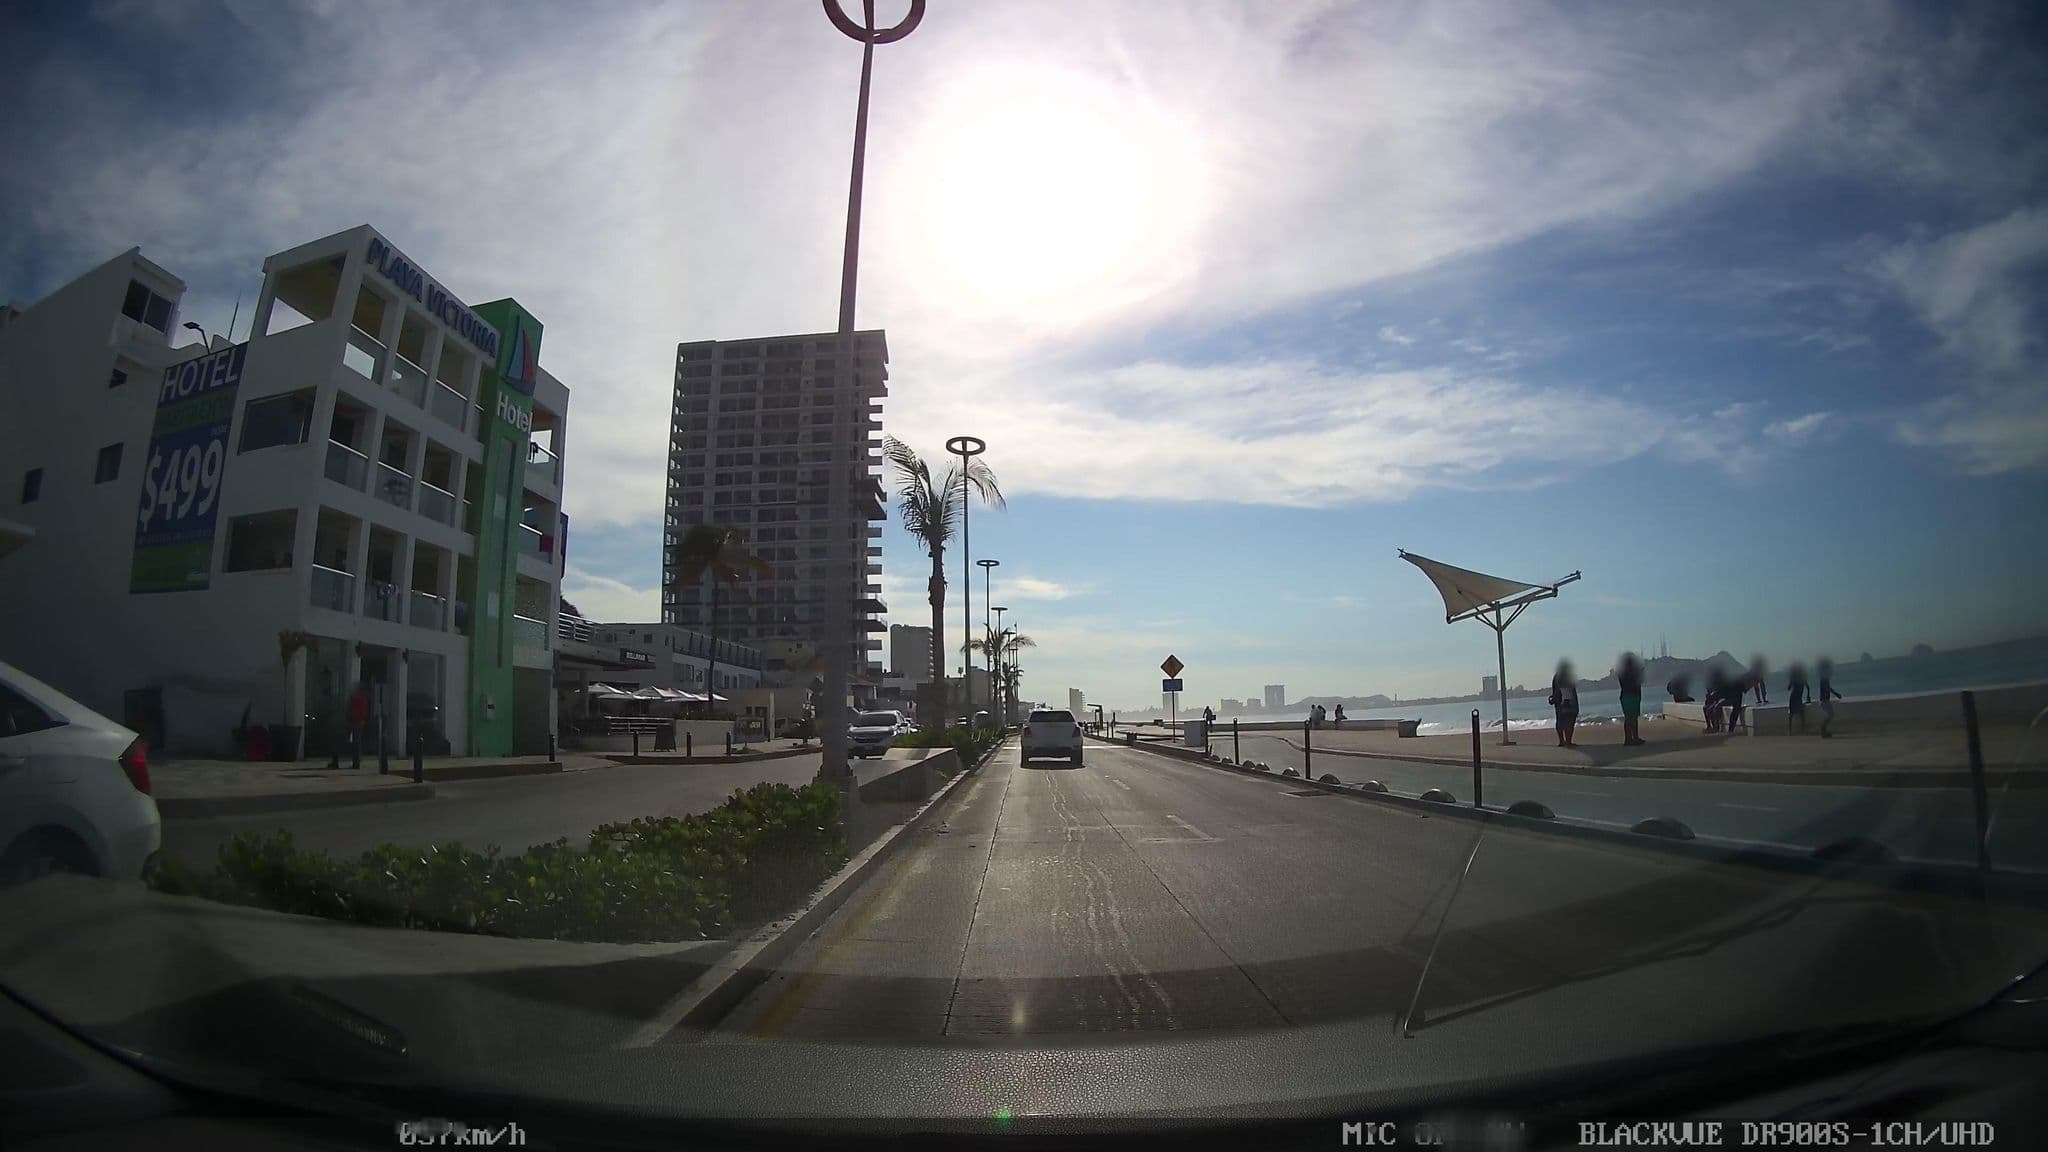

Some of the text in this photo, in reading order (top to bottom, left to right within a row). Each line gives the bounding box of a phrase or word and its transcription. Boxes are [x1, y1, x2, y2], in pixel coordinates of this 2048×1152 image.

[367, 237, 498, 359] PLAYA VICTORIA
[160, 349, 238, 403] HOTEL
[496, 391, 533, 433] Hotel
[139, 439, 224, 532] $499
